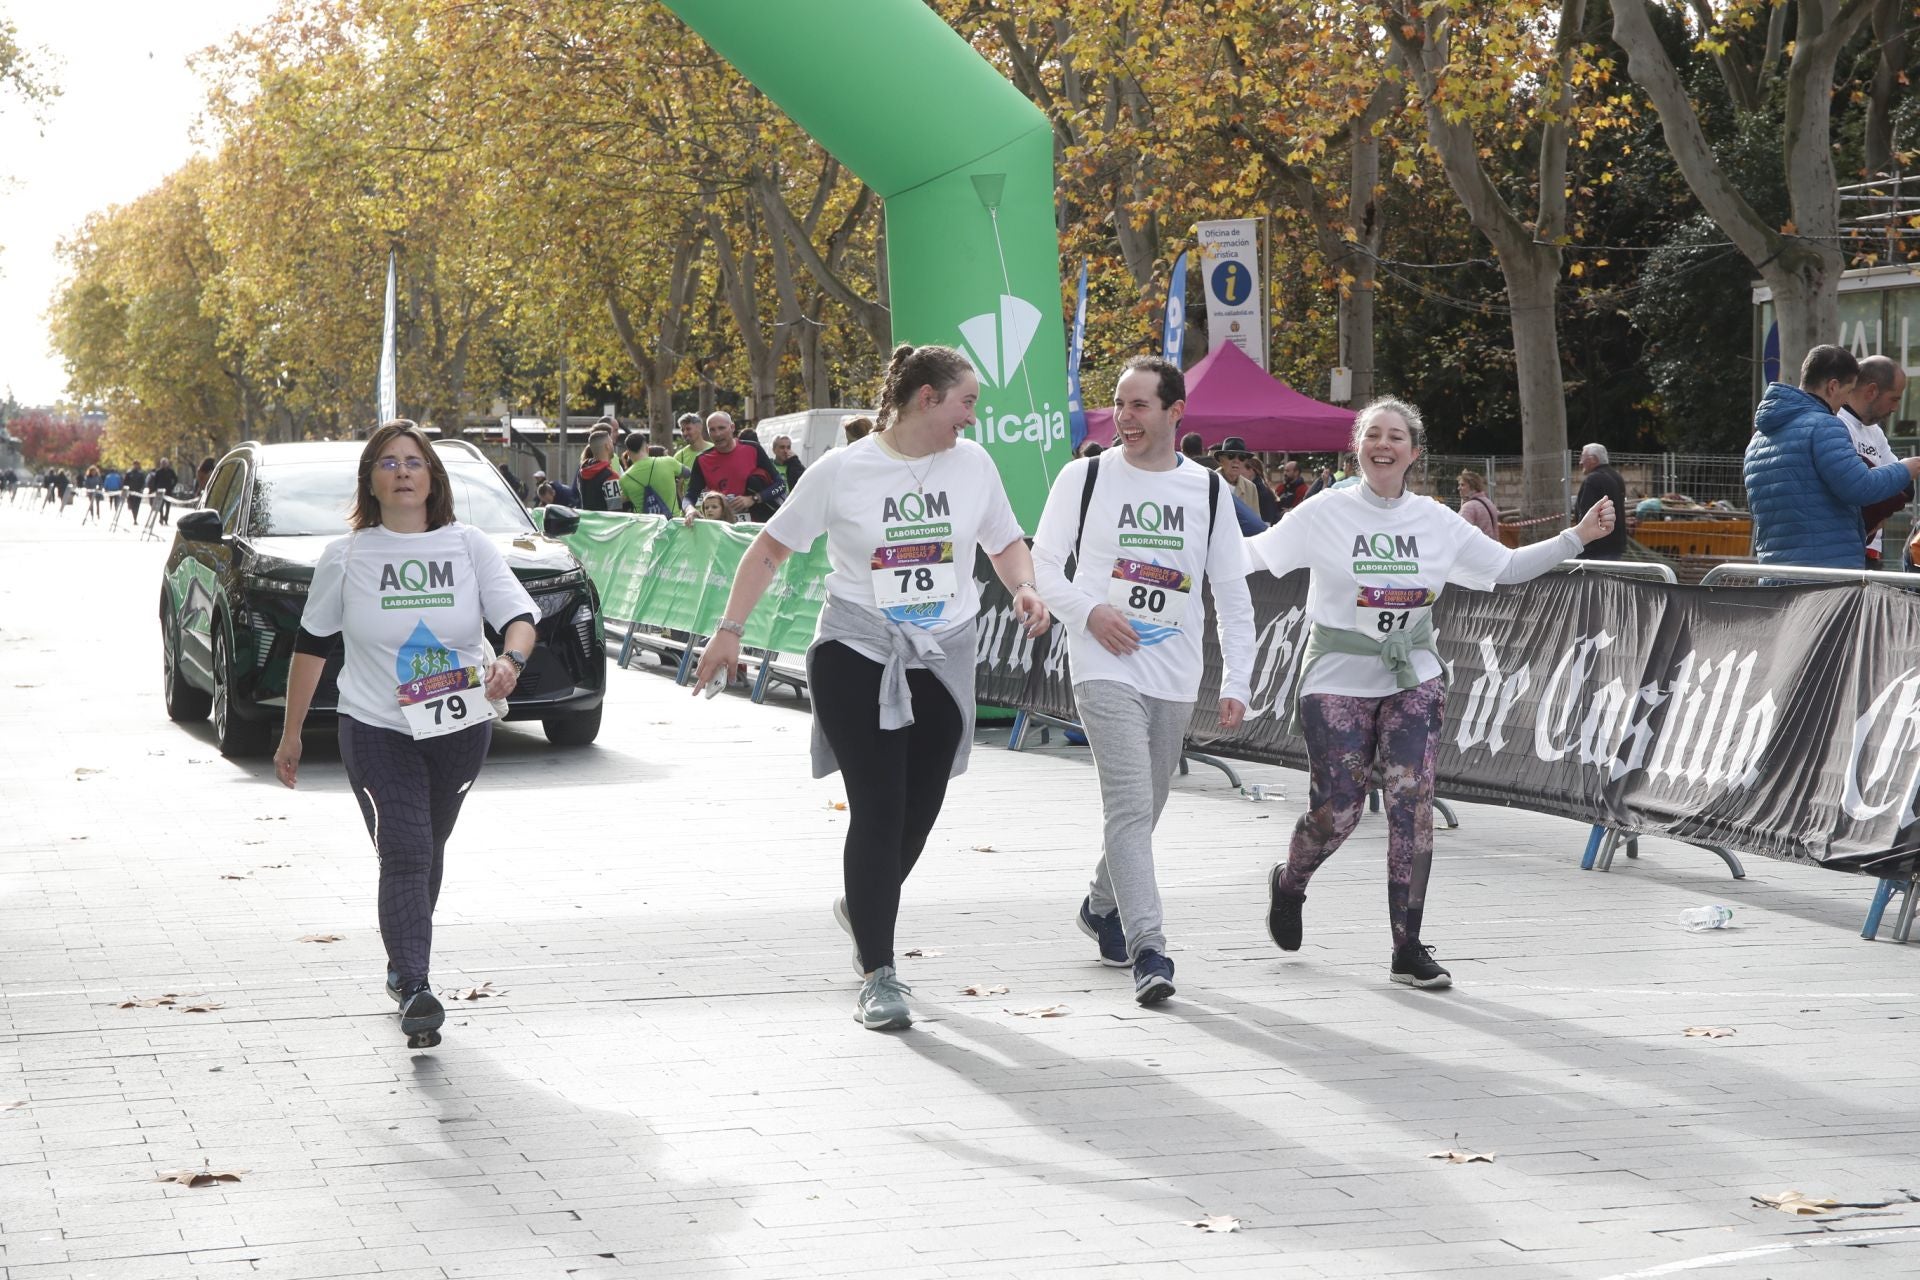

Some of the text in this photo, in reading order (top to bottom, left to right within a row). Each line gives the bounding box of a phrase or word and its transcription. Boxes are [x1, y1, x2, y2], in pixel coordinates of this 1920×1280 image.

[1206, 239, 1249, 248] Irmación
[1231, 228, 1240, 236] de
[957, 402, 1065, 452] nicaja
[882, 491, 950, 523] AQM
[1117, 501, 1184, 534] AQM
[888, 527, 949, 538] LABORATORIOS
[1122, 537, 1182, 547] LABORATORIOS
[897, 551, 927, 559] EMPRESAS
[1352, 533, 1419, 561] AQM
[379, 559, 454, 593] AQM
[894, 567, 934, 593] 78
[384, 597, 452, 607] LABORATORIOS
[1129, 585, 1166, 613] 80
[1377, 611, 1410, 633] 81
[425, 678, 456, 692] EMPRESAS
[425, 695, 467, 725] 79
[1455, 634, 1530, 757] de
[1535, 628, 1777, 792] Castilla
